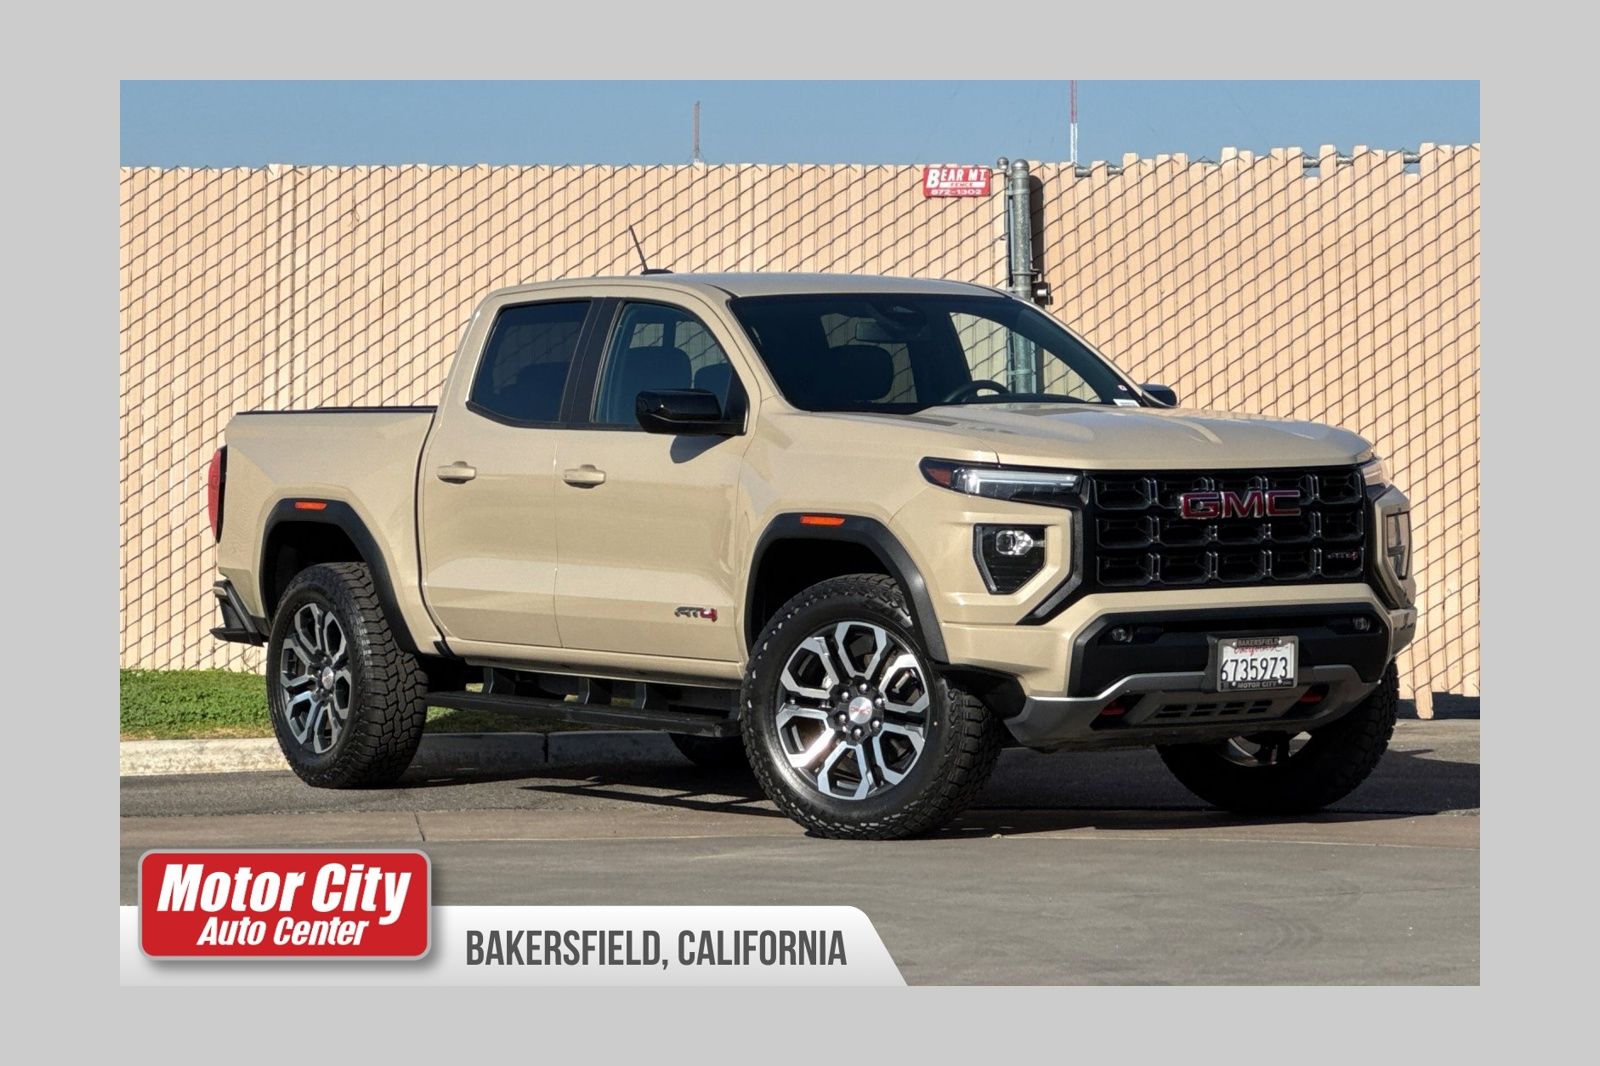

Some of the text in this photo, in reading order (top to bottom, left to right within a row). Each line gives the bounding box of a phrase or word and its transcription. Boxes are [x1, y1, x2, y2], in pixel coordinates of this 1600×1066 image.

[926, 168, 965, 188] BEAR
[1180, 489, 1301, 519] GMC
[673, 606, 718, 622] AT4
[1220, 657, 1288, 681] 67359Z3
